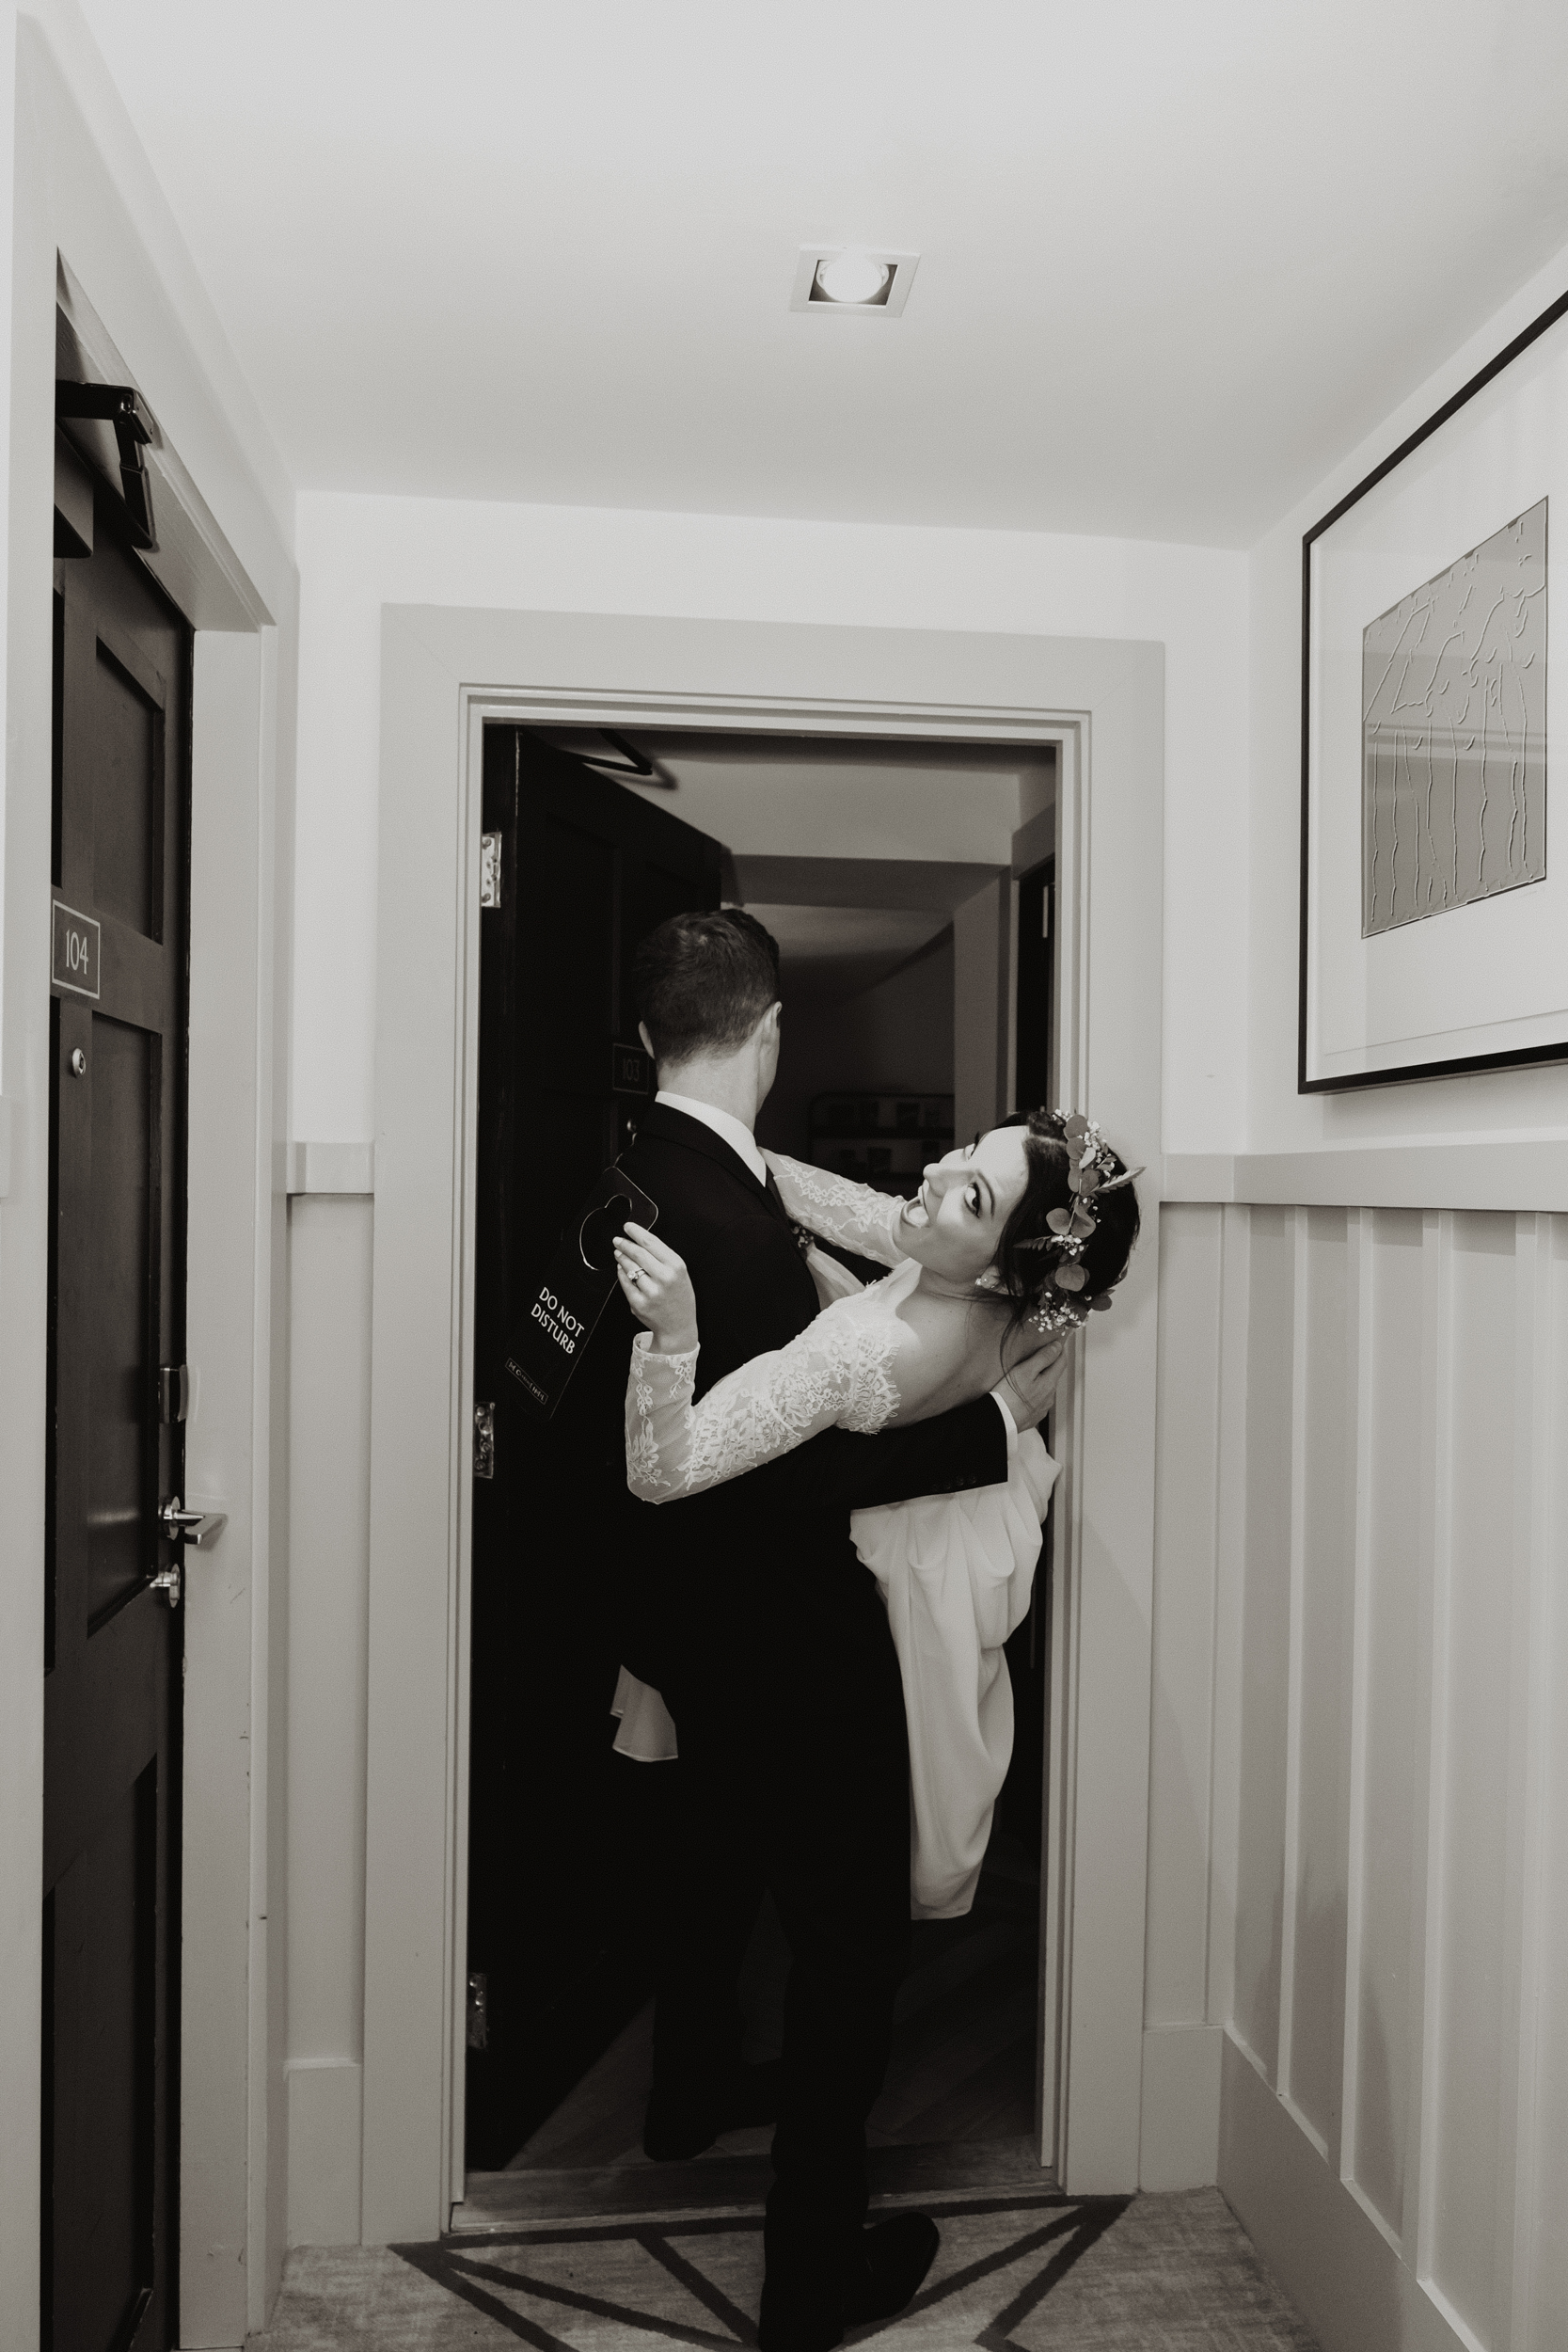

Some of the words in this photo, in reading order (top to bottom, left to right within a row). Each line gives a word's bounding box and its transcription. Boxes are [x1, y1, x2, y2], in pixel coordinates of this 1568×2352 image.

[66, 929, 88, 975] 104
[531, 1303, 575, 1354] DISTURB
[539, 1287, 558, 1310] DO
[557, 1306, 584, 1337] NOT
